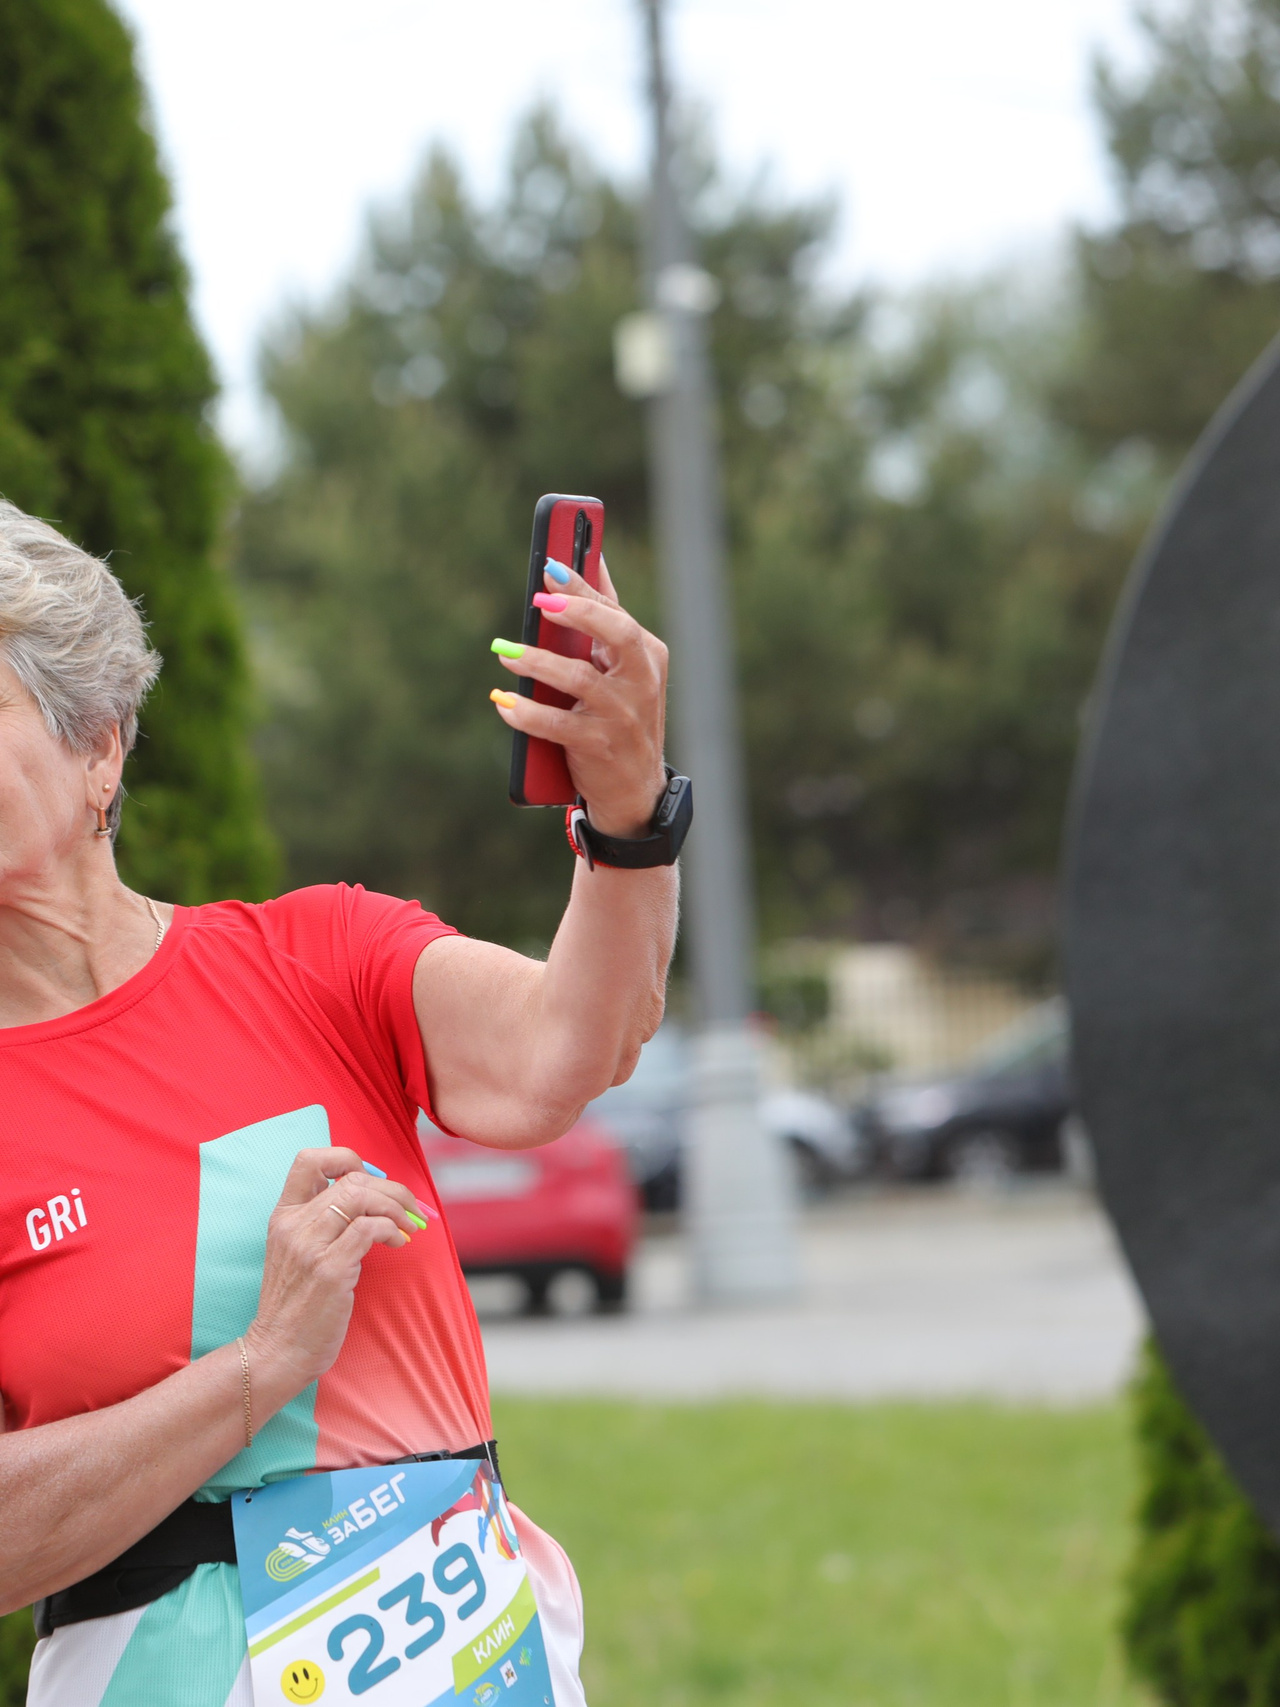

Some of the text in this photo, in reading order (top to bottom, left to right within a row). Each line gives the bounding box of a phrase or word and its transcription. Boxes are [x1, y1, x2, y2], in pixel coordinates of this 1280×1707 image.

[25, 1187, 88, 1251] GRi
[321, 1508, 349, 1529] КЛИН
[327, 1471, 406, 1546] ЗАБЕГ
[326, 1542, 487, 1696] 239
[472, 1613, 516, 1665] КЛИН
